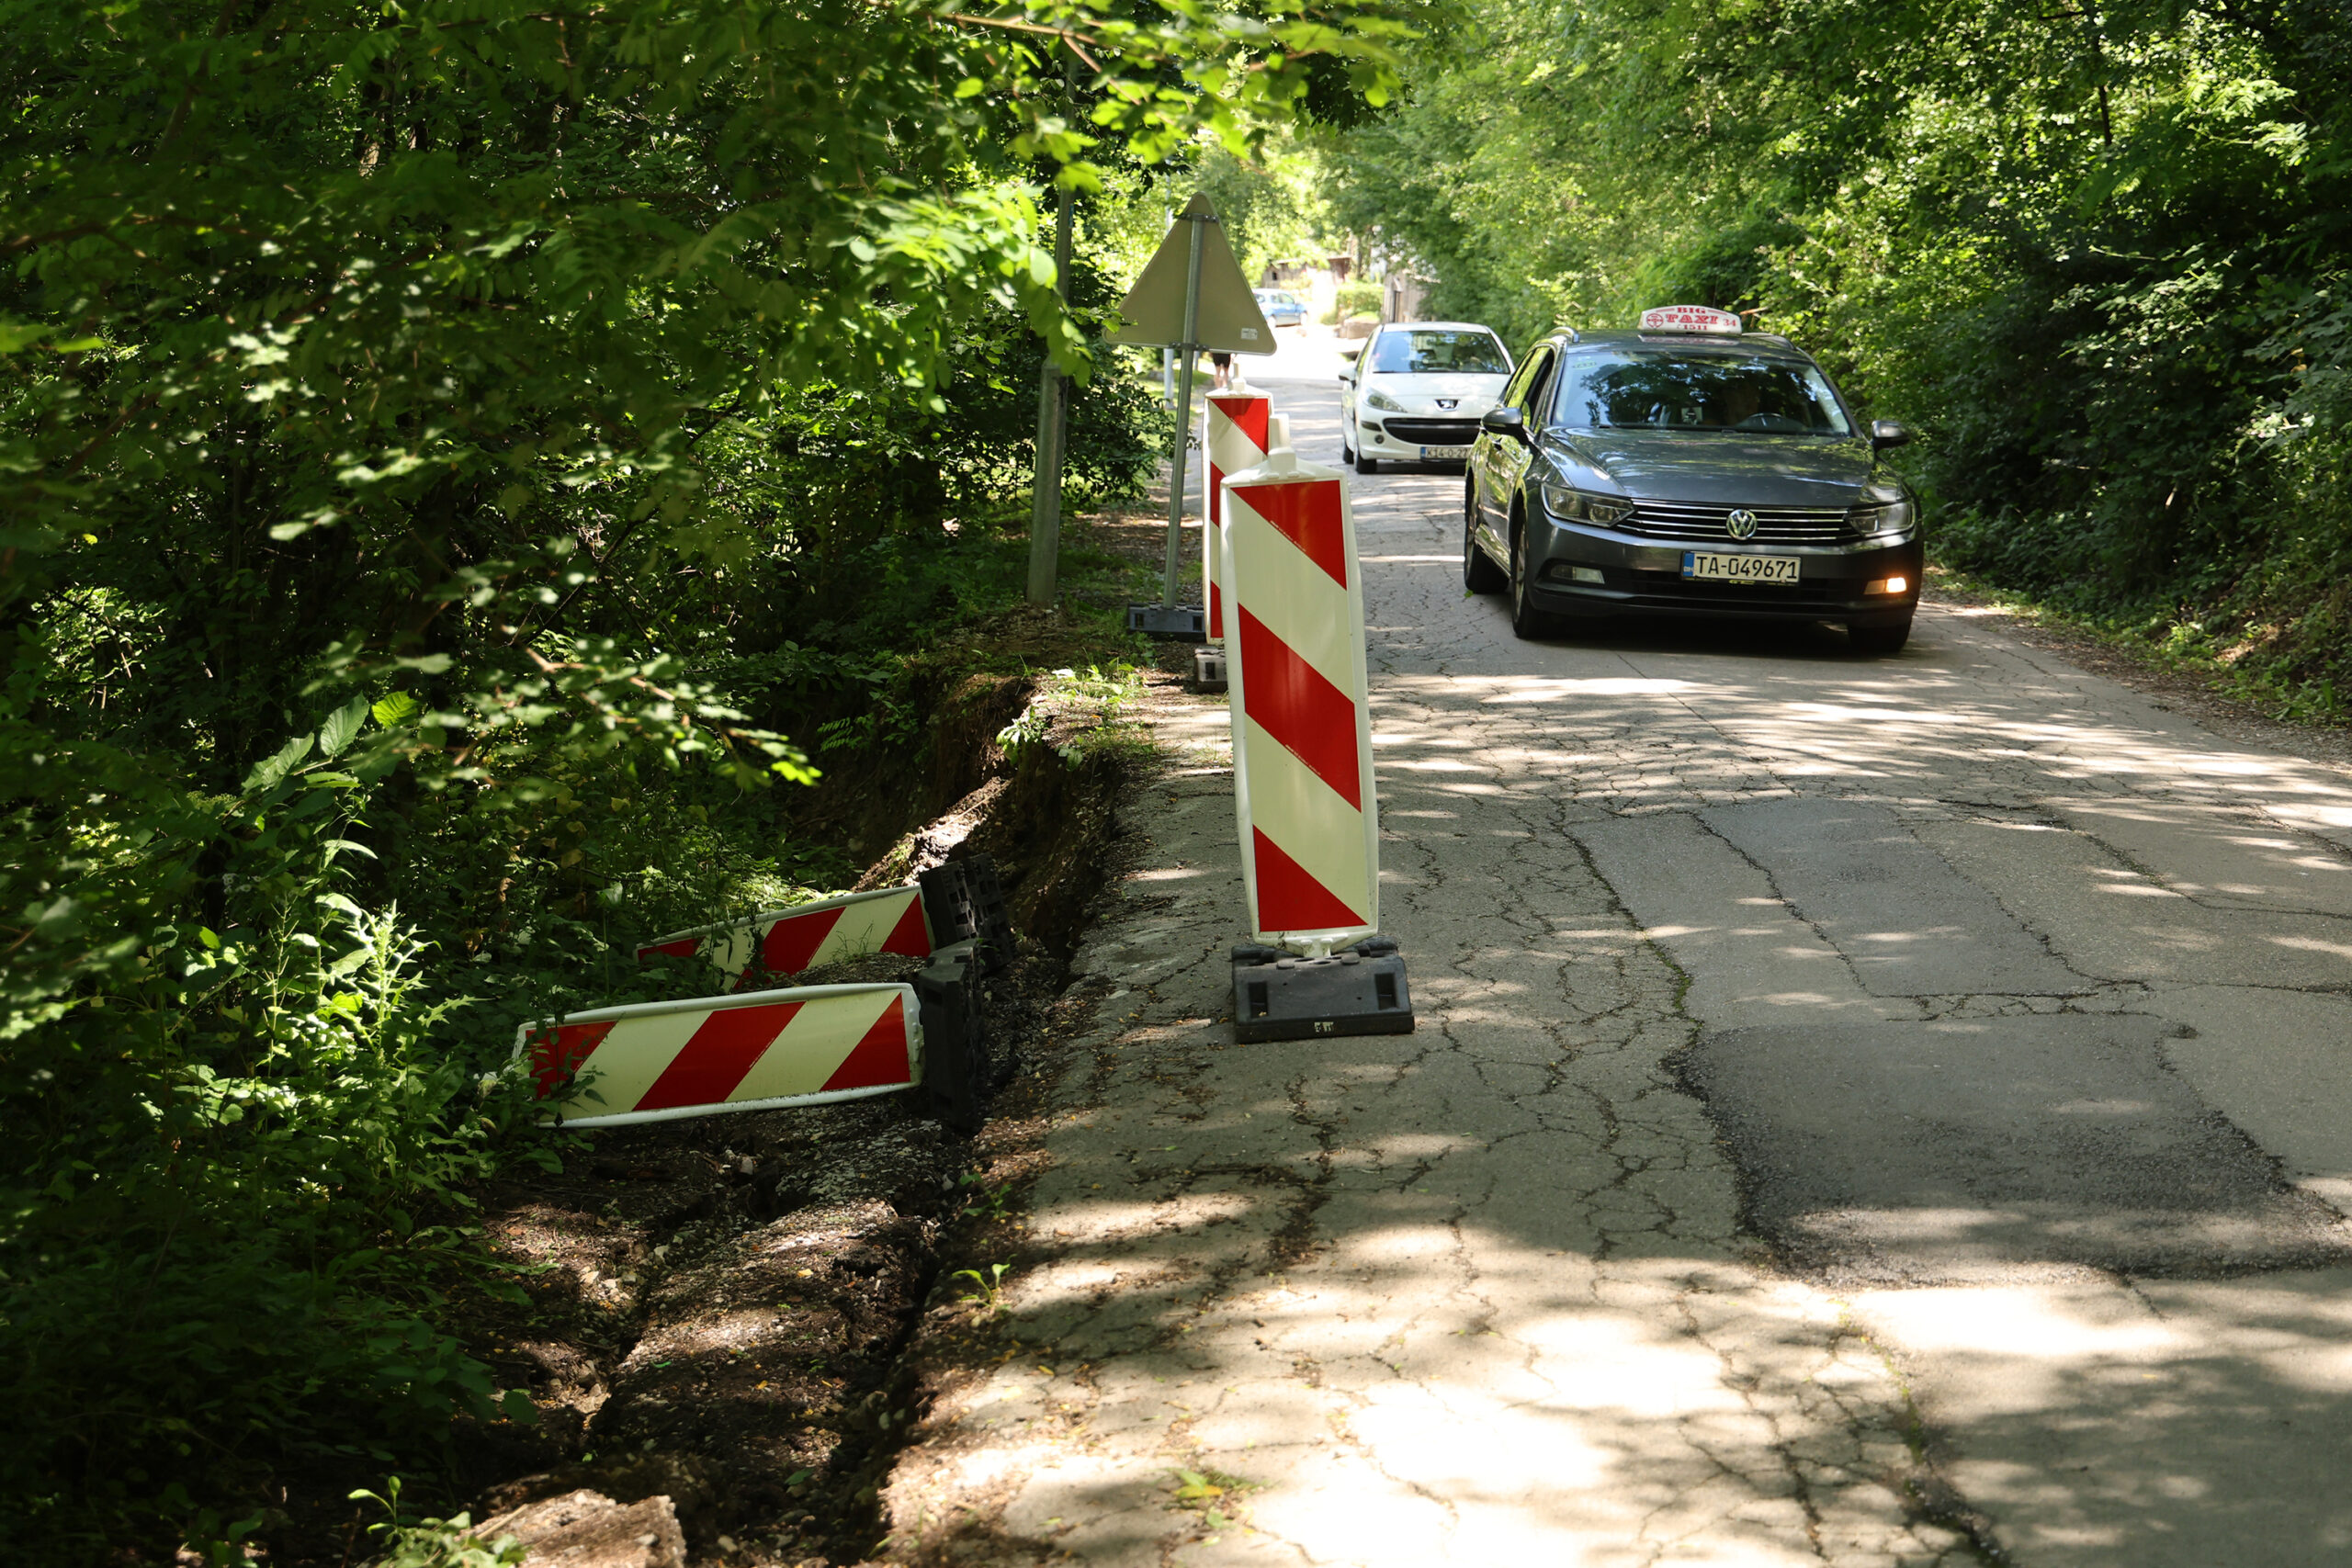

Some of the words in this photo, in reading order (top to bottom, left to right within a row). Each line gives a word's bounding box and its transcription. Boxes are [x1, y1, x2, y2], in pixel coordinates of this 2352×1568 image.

[1666, 314, 1719, 324] TAXI
[1723, 318, 1736, 327] 34
[1696, 556, 1797, 580] TA-049671
